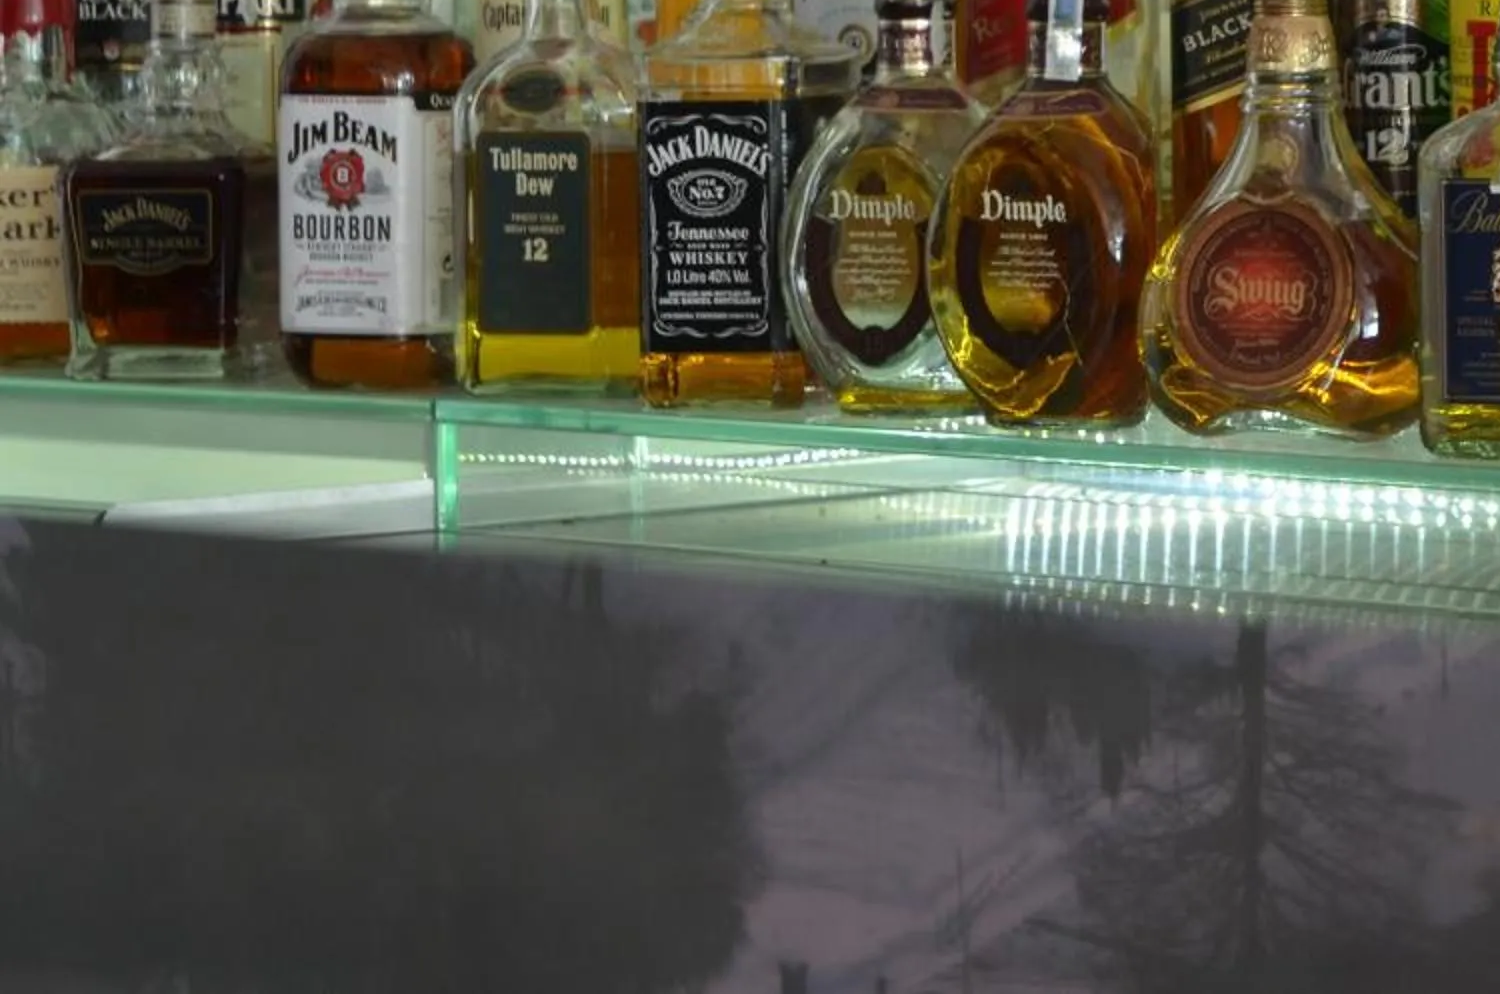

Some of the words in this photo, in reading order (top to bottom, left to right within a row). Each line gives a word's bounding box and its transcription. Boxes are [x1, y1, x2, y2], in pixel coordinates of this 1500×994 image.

[77, 4, 148, 22] BLACK
[1183, 11, 1253, 53] BLACK
[288, 121, 328, 164] JIM
[333, 110, 397, 164] BEAM
[647, 138, 692, 177] JACK
[694, 124, 773, 178] DANIEL'S
[1367, 128, 1409, 166] 12
[489, 147, 578, 171] Tullamore
[515, 172, 554, 196] Dew
[830, 189, 916, 226] Dimple
[981, 190, 1068, 229] Dimple
[293, 214, 391, 242] BOURBON
[522, 237, 549, 262] 12
[669, 251, 749, 265] WHISKEY
[1208, 265, 1310, 314] Swing
